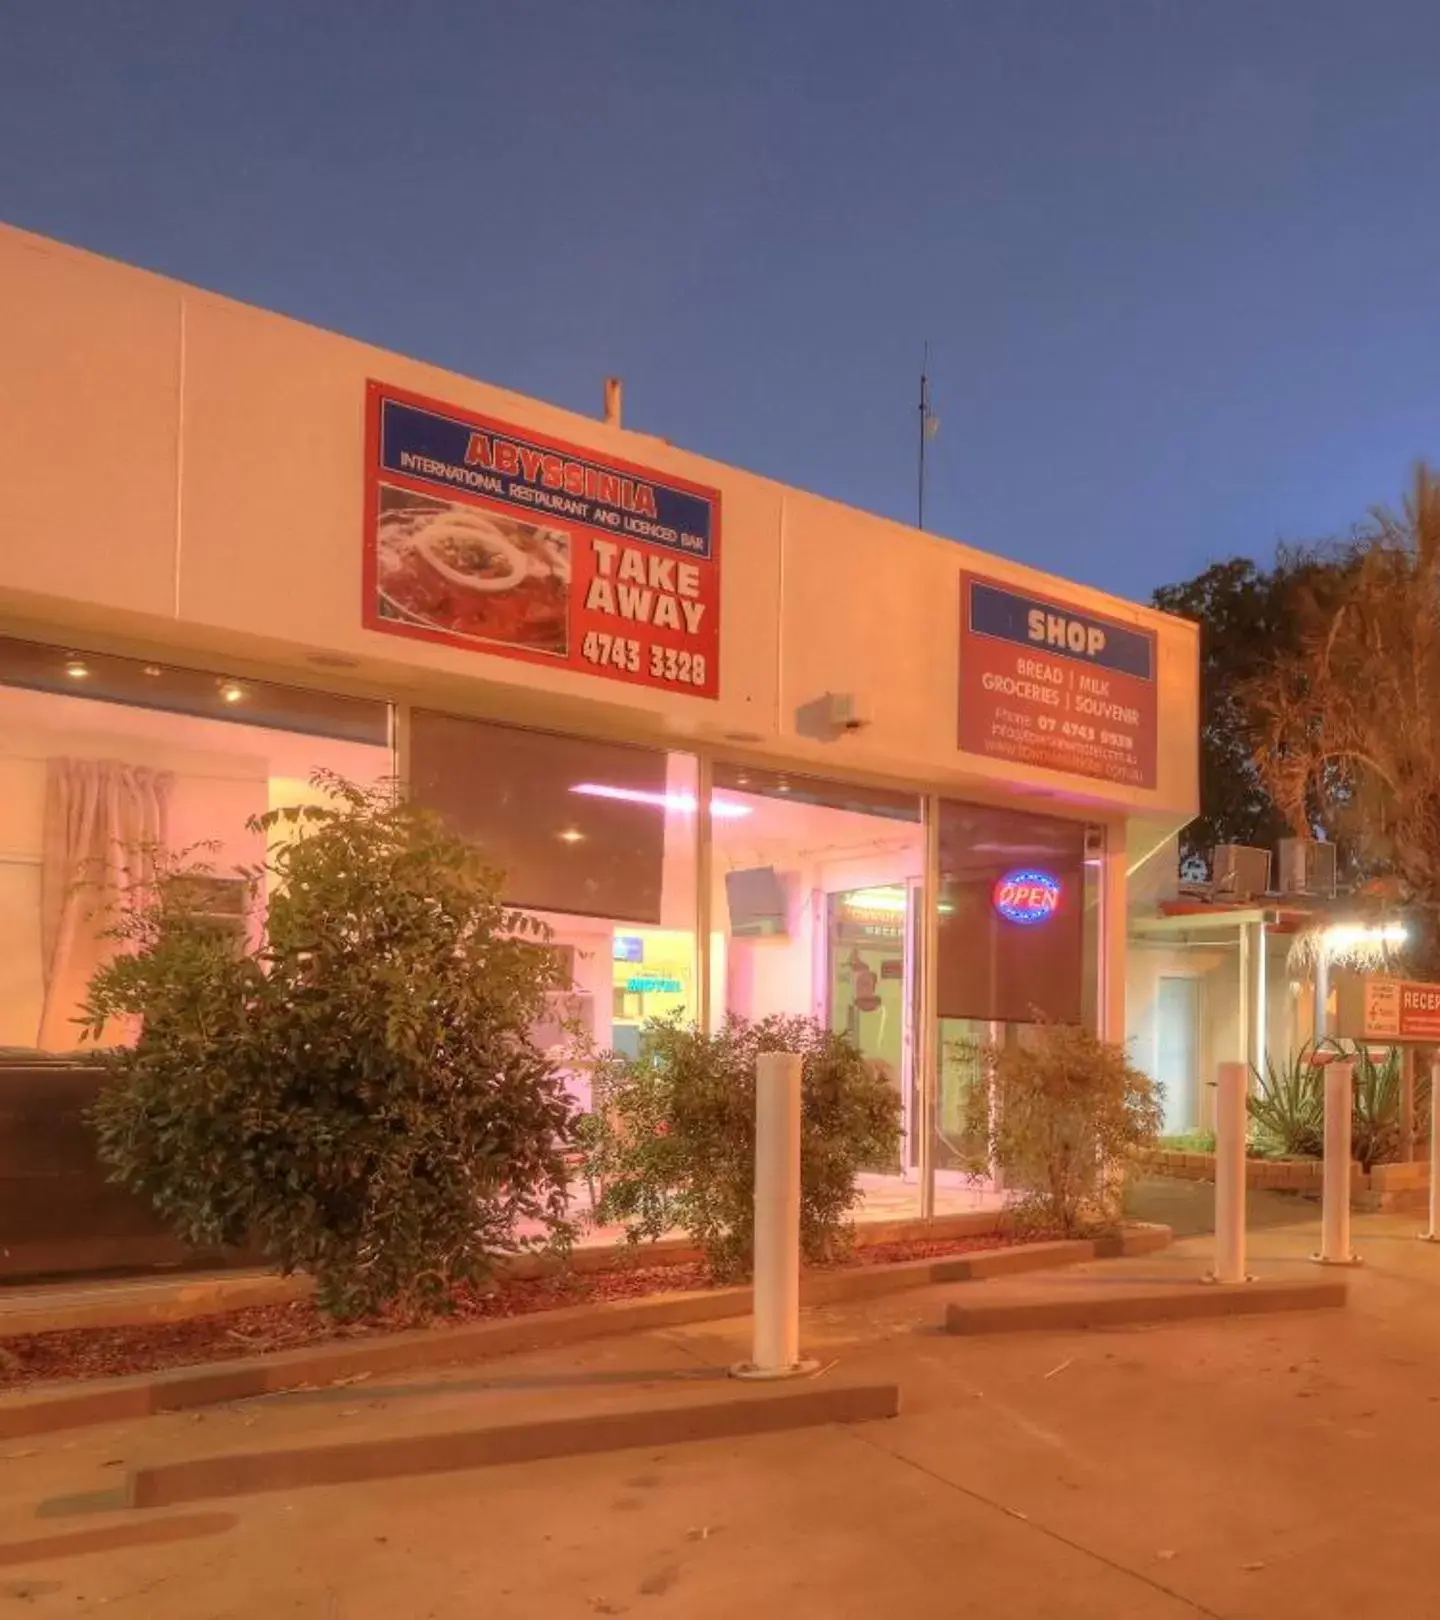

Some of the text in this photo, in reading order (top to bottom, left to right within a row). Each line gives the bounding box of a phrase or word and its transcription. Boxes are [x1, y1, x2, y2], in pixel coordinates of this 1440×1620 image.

[401, 450, 705, 551] INTERNATIONAL RESTAURANT AND LICENCED BAR
[464, 431, 658, 518] ABYSSINIA
[591, 539, 699, 597] TAKE
[586, 578, 706, 634] AWAY
[1028, 609, 1106, 656] SHOP
[583, 631, 706, 687] 4743 3328
[1017, 657, 1111, 697] BREAD MILK
[982, 672, 1140, 726] GROCERIES SOUVENIR
[1037, 714, 1056, 732] 07
[1000, 885, 1057, 911] OPEN
